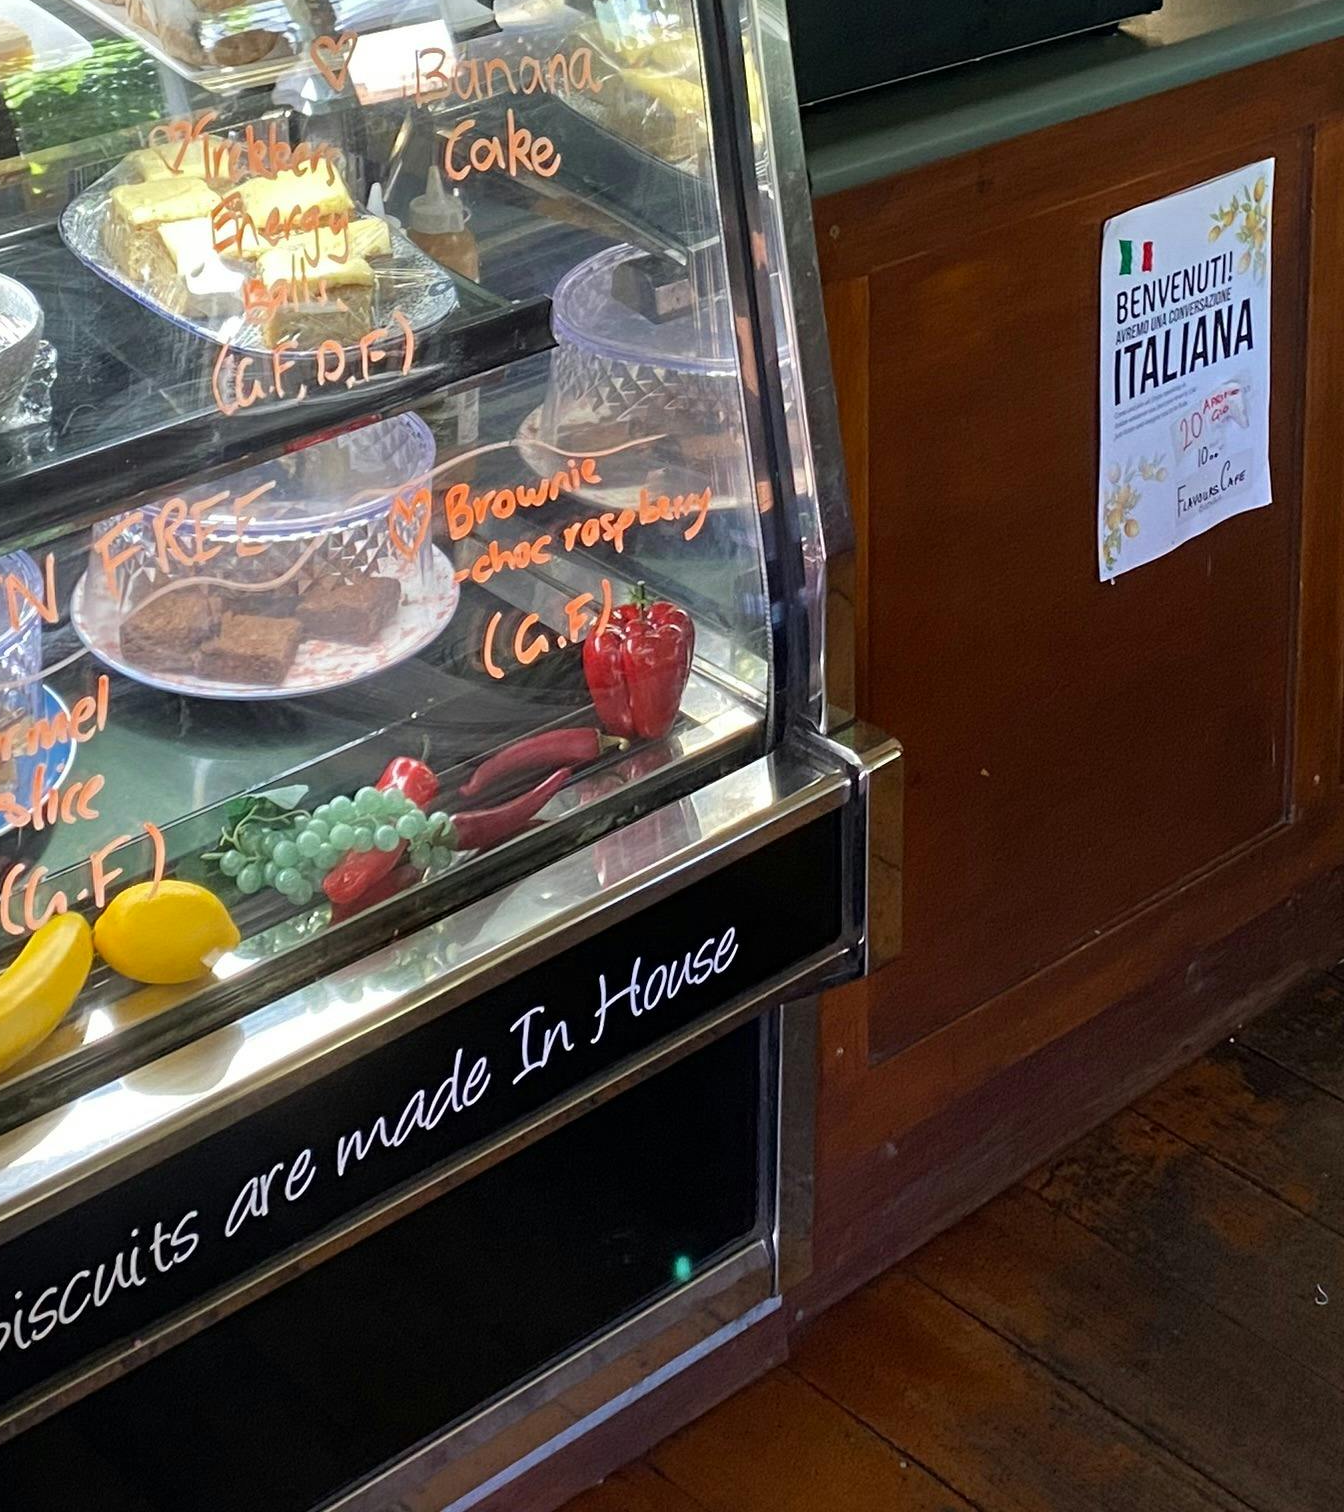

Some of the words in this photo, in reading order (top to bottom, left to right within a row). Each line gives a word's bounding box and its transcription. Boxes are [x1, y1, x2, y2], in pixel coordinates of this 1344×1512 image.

[414, 46, 604, 105] Banana
[211, 192, 353, 268] Energy
[1115, 324, 1148, 346] AVREMO
[1150, 316, 1167, 332] UNA
[1168, 287, 1232, 325] CONVERSAZIONE
[1116, 251, 1233, 325] BENVENUTI!
[1114, 297, 1254, 407] ITALIANA
[1180, 412, 1203, 451] 20
[444, 457, 602, 541] Brownie
[93, 480, 277, 599] FREE
[224, 1147, 317, 1240] are
[337, 1047, 491, 1177] made
[509, 1005, 574, 1086] In
[590, 927, 740, 1045] House
